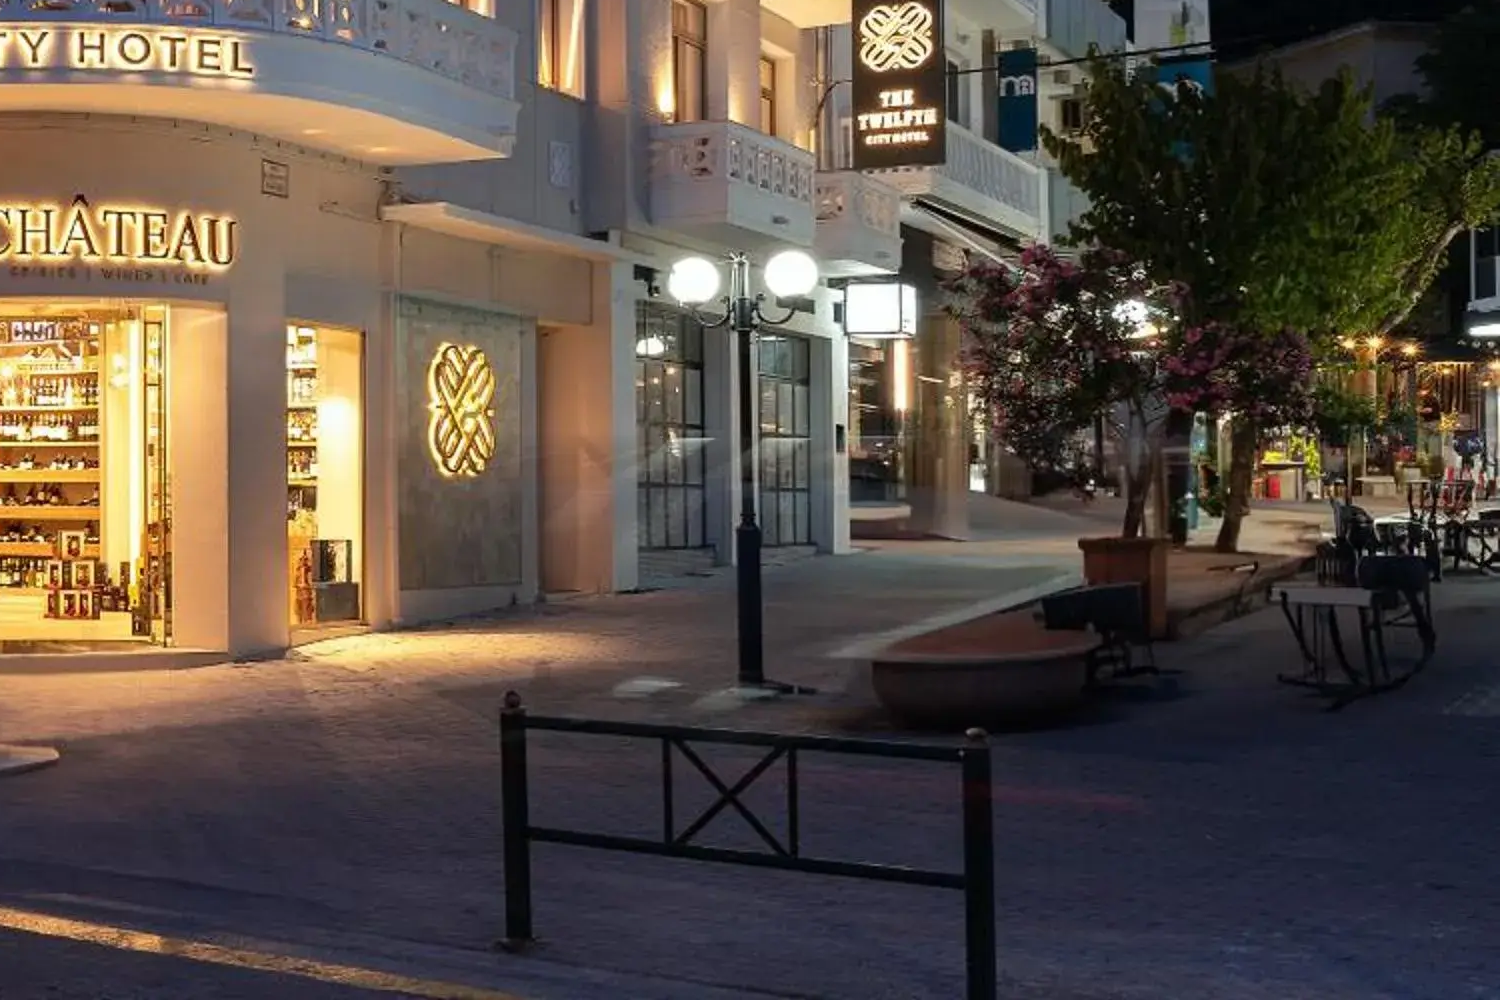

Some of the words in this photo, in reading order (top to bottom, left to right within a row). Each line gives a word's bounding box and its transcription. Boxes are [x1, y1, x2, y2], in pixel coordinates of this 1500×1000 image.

[77, 31, 253, 74] HOTEL
[879, 88, 915, 108] THE
[857, 107, 938, 131] TWELFTH
